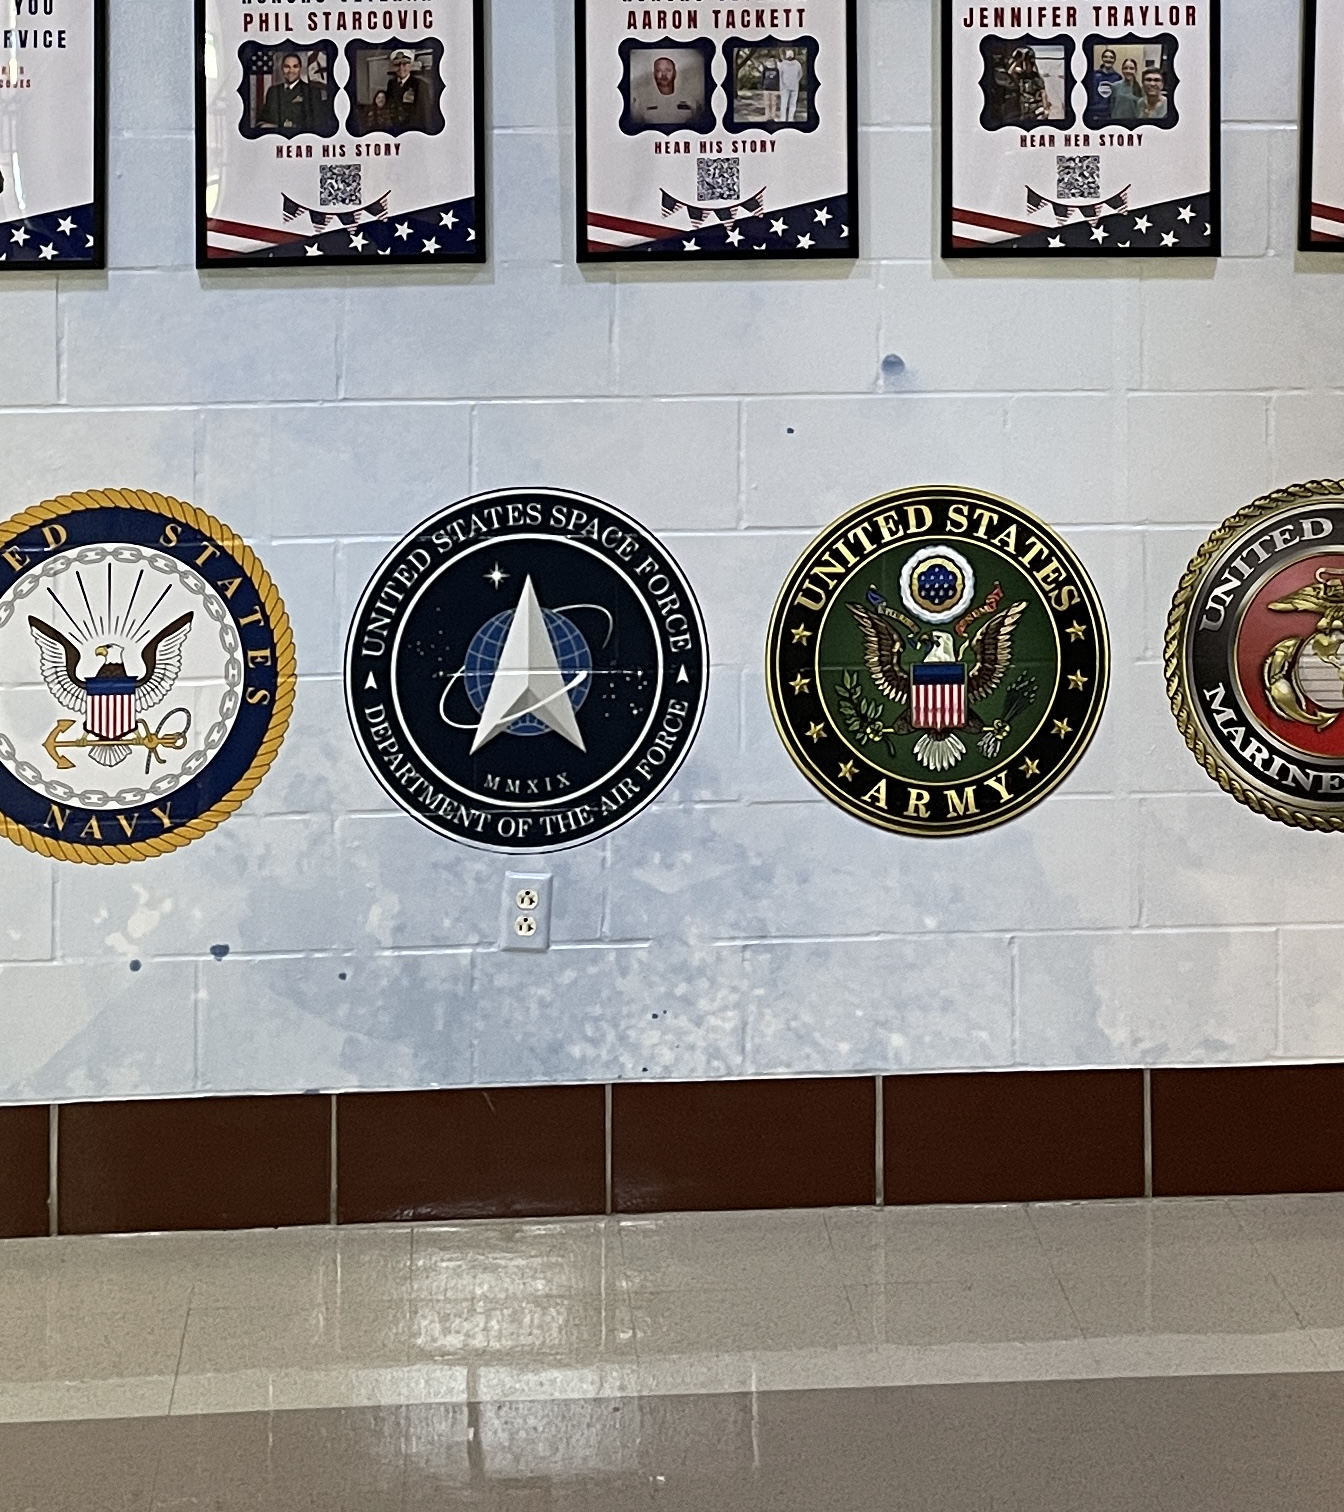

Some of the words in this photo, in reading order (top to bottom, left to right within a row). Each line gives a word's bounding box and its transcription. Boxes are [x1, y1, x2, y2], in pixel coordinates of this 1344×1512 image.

[244, 13, 293, 32] PHIL
[308, 10, 432, 31] STARCOVIC
[627, 10, 697, 29] AARON
[712, 9, 805, 28] TACKETT
[964, 7, 1076, 27] JENNIFER
[1093, 6, 1195, 26] TRAYLOR
[277, 145, 312, 158] HEAR
[323, 145, 345, 157] HIS
[356, 143, 400, 156] STORY
[655, 142, 690, 154] HEAR
[700, 141, 722, 153] HIS
[732, 140, 775, 153] STORY
[1021, 135, 1055, 147] HEAR
[1065, 134, 1089, 147] HER
[1100, 134, 1142, 146] STORY
[794, 505, 933, 612] UNITED
[945, 504, 1081, 612] STATES
[362, 548, 431, 658] UNITED
[431, 503, 542, 554] STATES
[549, 505, 639, 562] SPACE
[634, 556, 692, 652] FORCE
[1199, 517, 1333, 632] UNITED
[160, 523, 271, 706] STATES
[365, 703, 492, 833] DEPARTMENT
[497, 817, 533, 837] OF
[539, 805, 594, 836] THE
[600, 777, 641, 815] AIR
[636, 699, 688, 782] FORCE
[484, 773, 571, 794] MMXIX
[861, 770, 1015, 818] ARMY
[44, 802, 175, 839] NAVY
